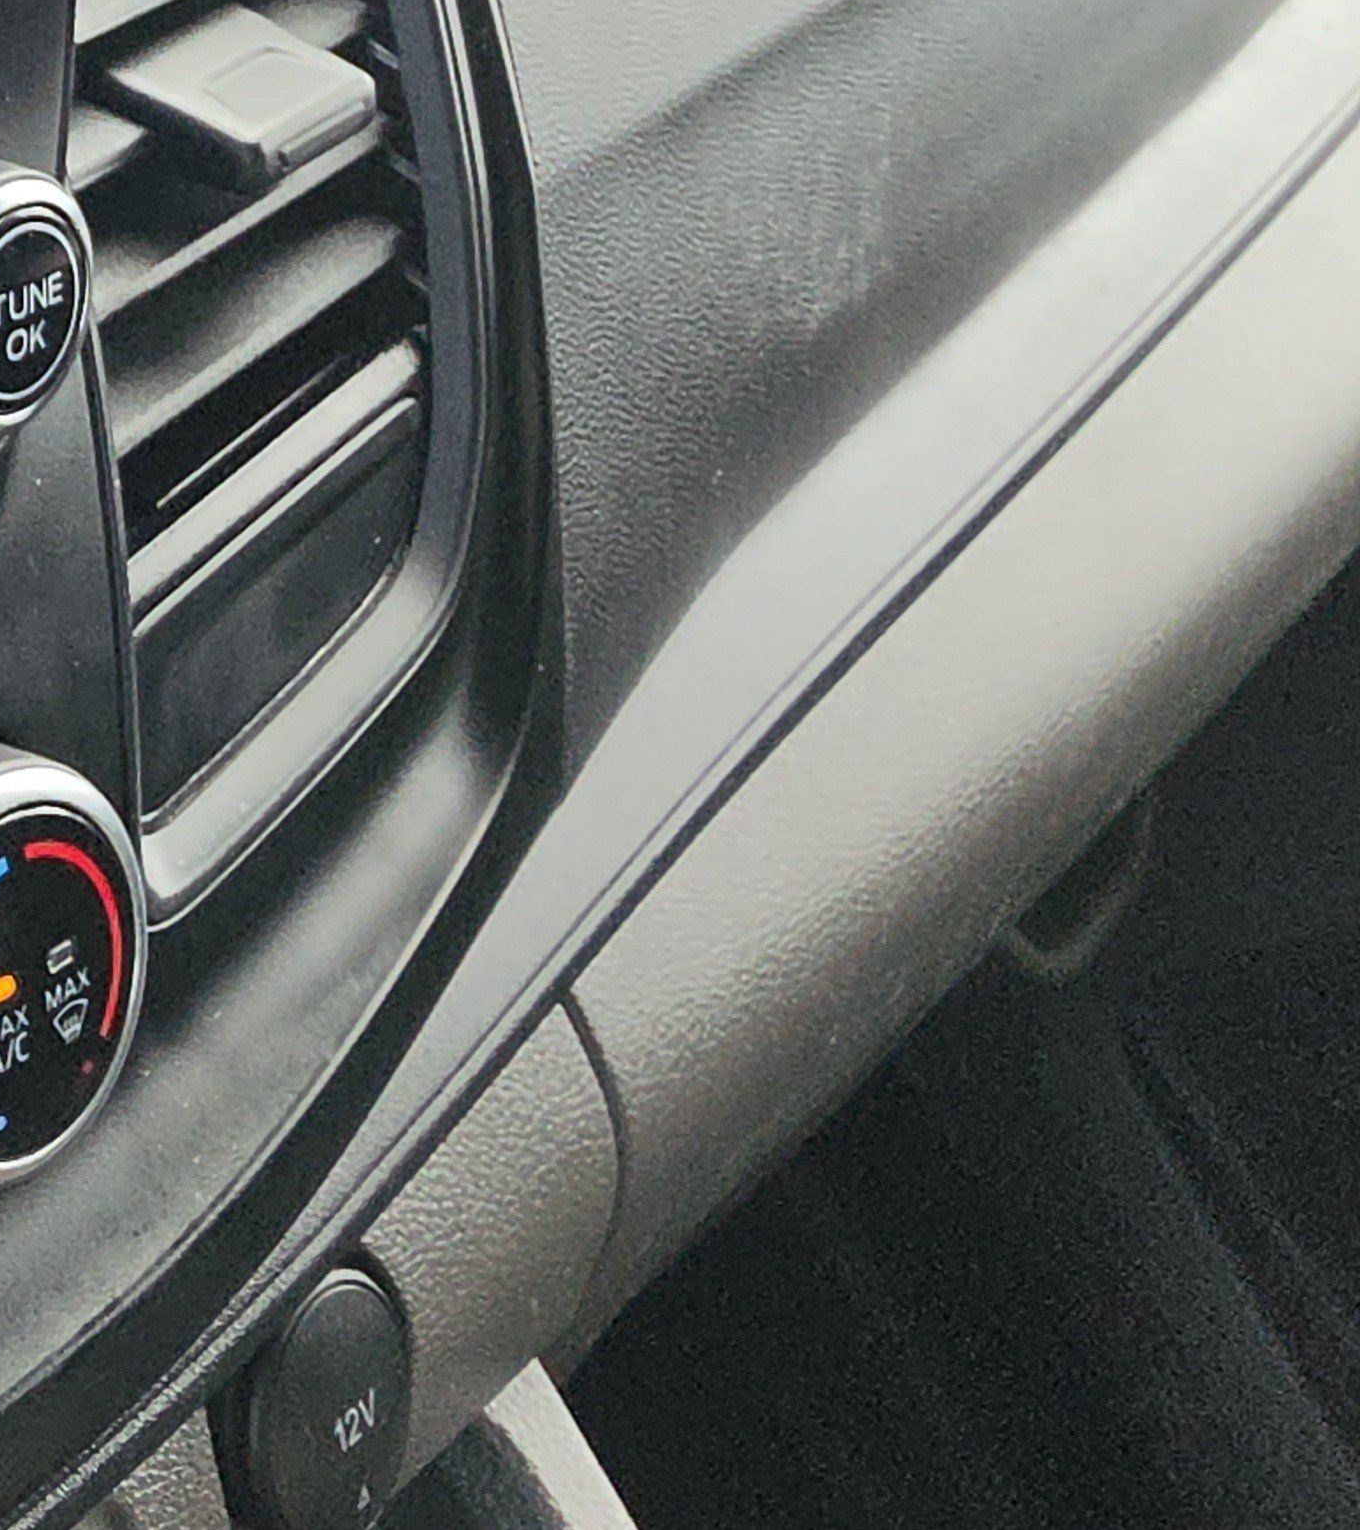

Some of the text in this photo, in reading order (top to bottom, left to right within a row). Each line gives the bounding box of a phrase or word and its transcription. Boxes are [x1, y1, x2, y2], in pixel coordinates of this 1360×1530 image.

[4, 318, 48, 363] OK
[44, 966, 91, 1012] MAX
[333, 1386, 375, 1453] 12V
